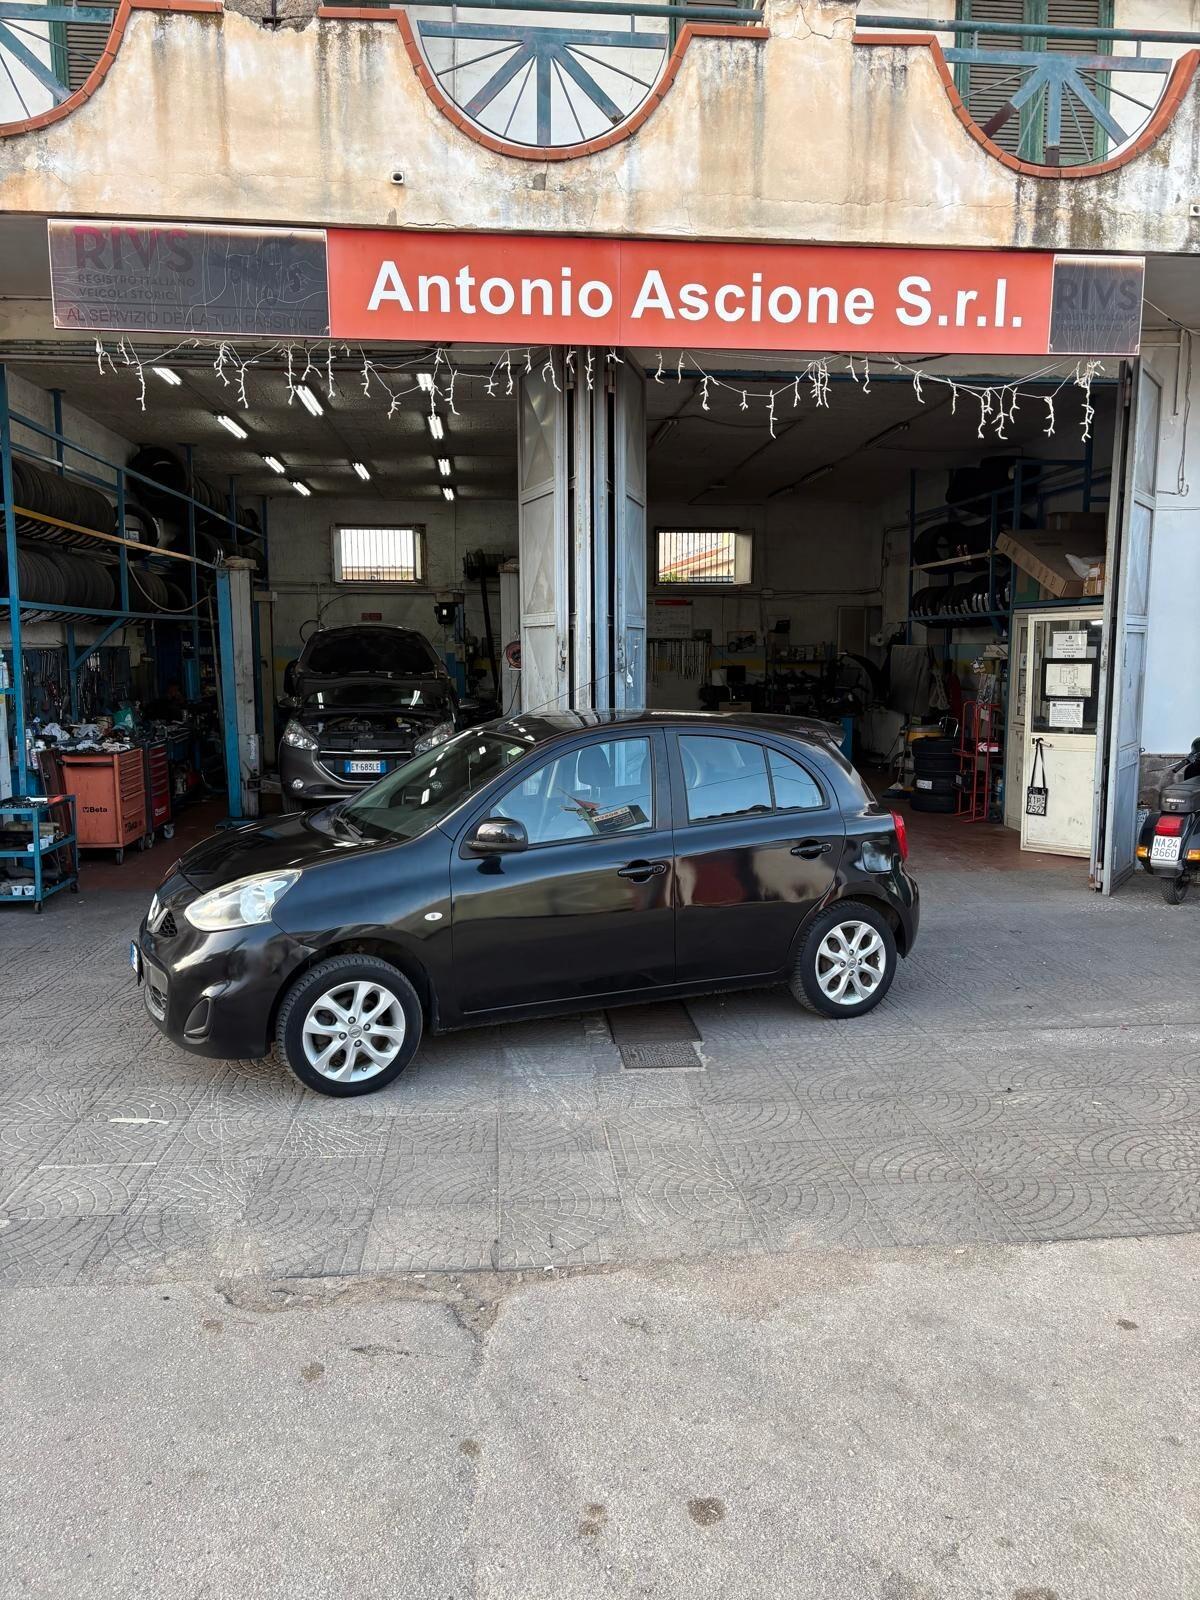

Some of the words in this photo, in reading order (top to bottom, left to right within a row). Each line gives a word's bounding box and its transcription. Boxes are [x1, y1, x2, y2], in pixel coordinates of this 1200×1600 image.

[72, 226, 194, 272] RIVS
[367, 260, 613, 318] Antonio
[630, 269, 875, 325] Ascione
[895, 275, 1022, 328] S.r.l.
[1056, 278, 1138, 311] RIVS
[66, 307, 86, 322] AL
[89, 309, 158, 324] SERVIZIO
[162, 311, 208, 326] DELLA
[1152, 848, 1177, 857] 3660
